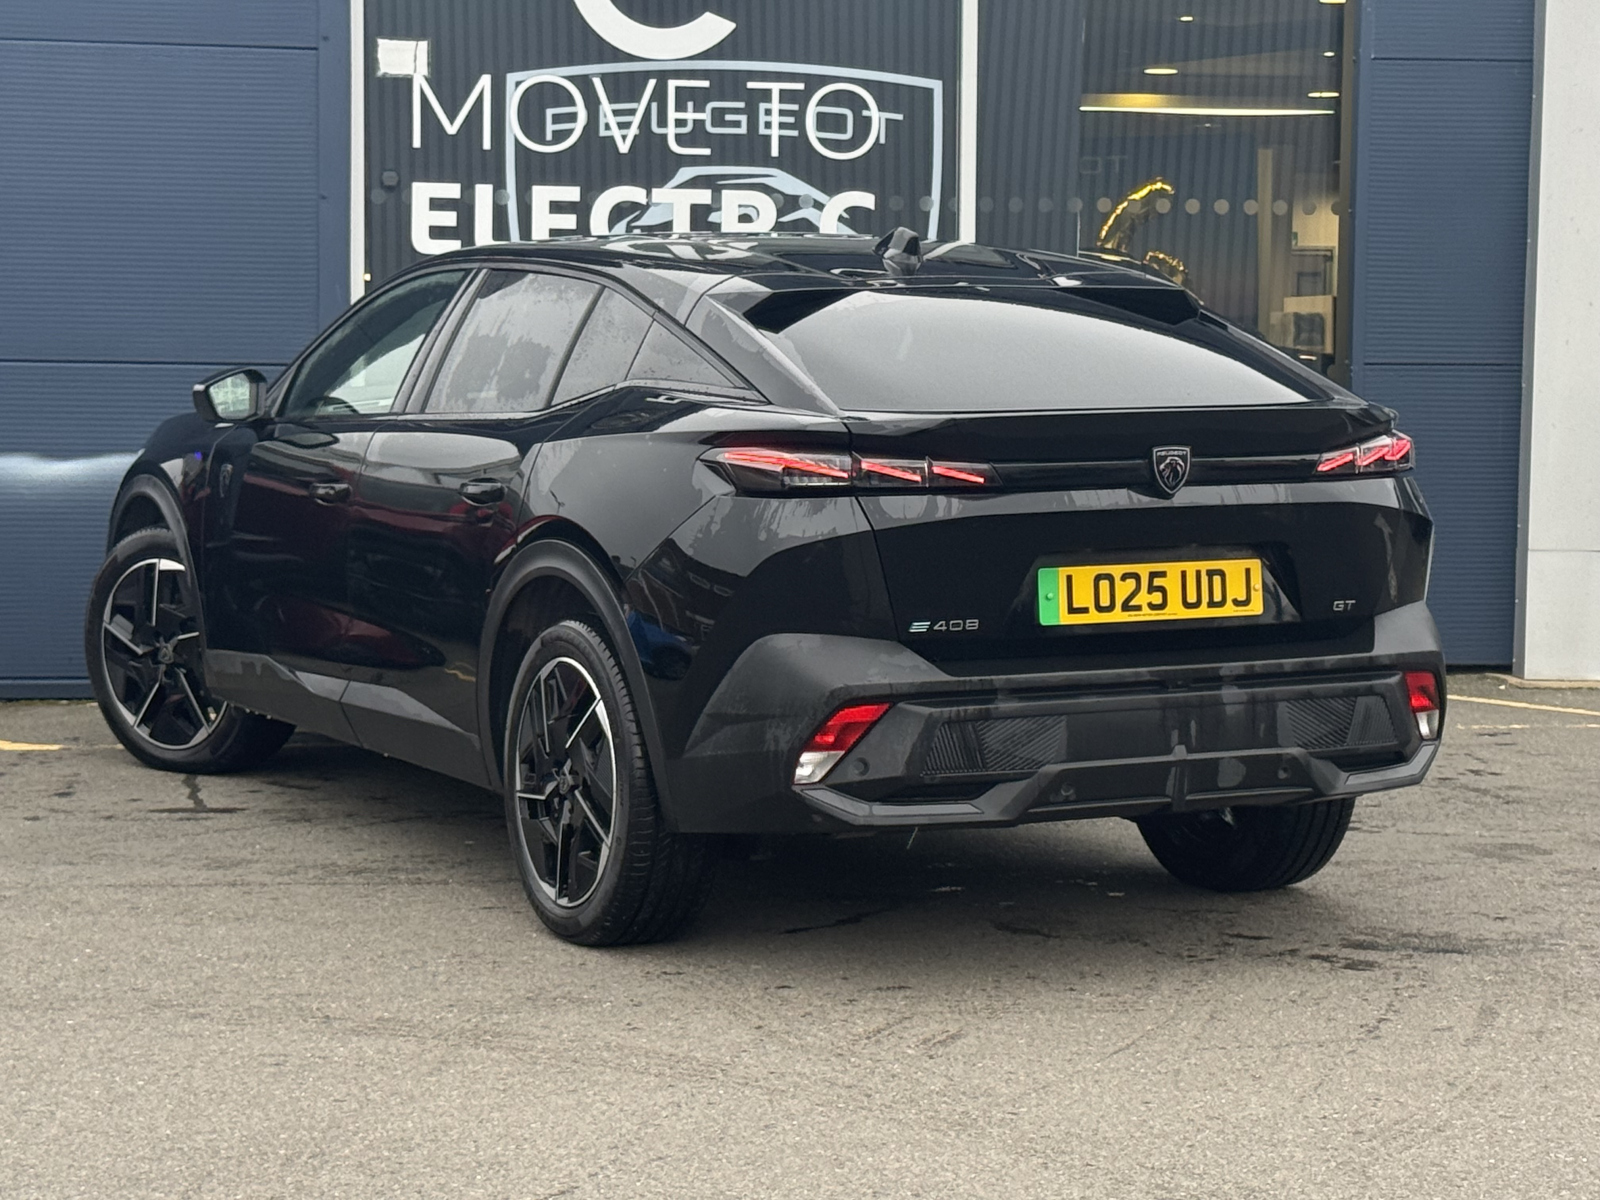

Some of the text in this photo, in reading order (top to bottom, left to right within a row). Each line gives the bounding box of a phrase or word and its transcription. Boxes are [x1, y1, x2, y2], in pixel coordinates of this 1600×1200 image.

[411, 74, 881, 161] MOVE TO
[546, 101, 904, 144] PEUGEOT
[410, 182, 876, 255] ELECTRC
[1065, 567, 1252, 615] LO25 UDJ
[1332, 600, 1356, 611] GT
